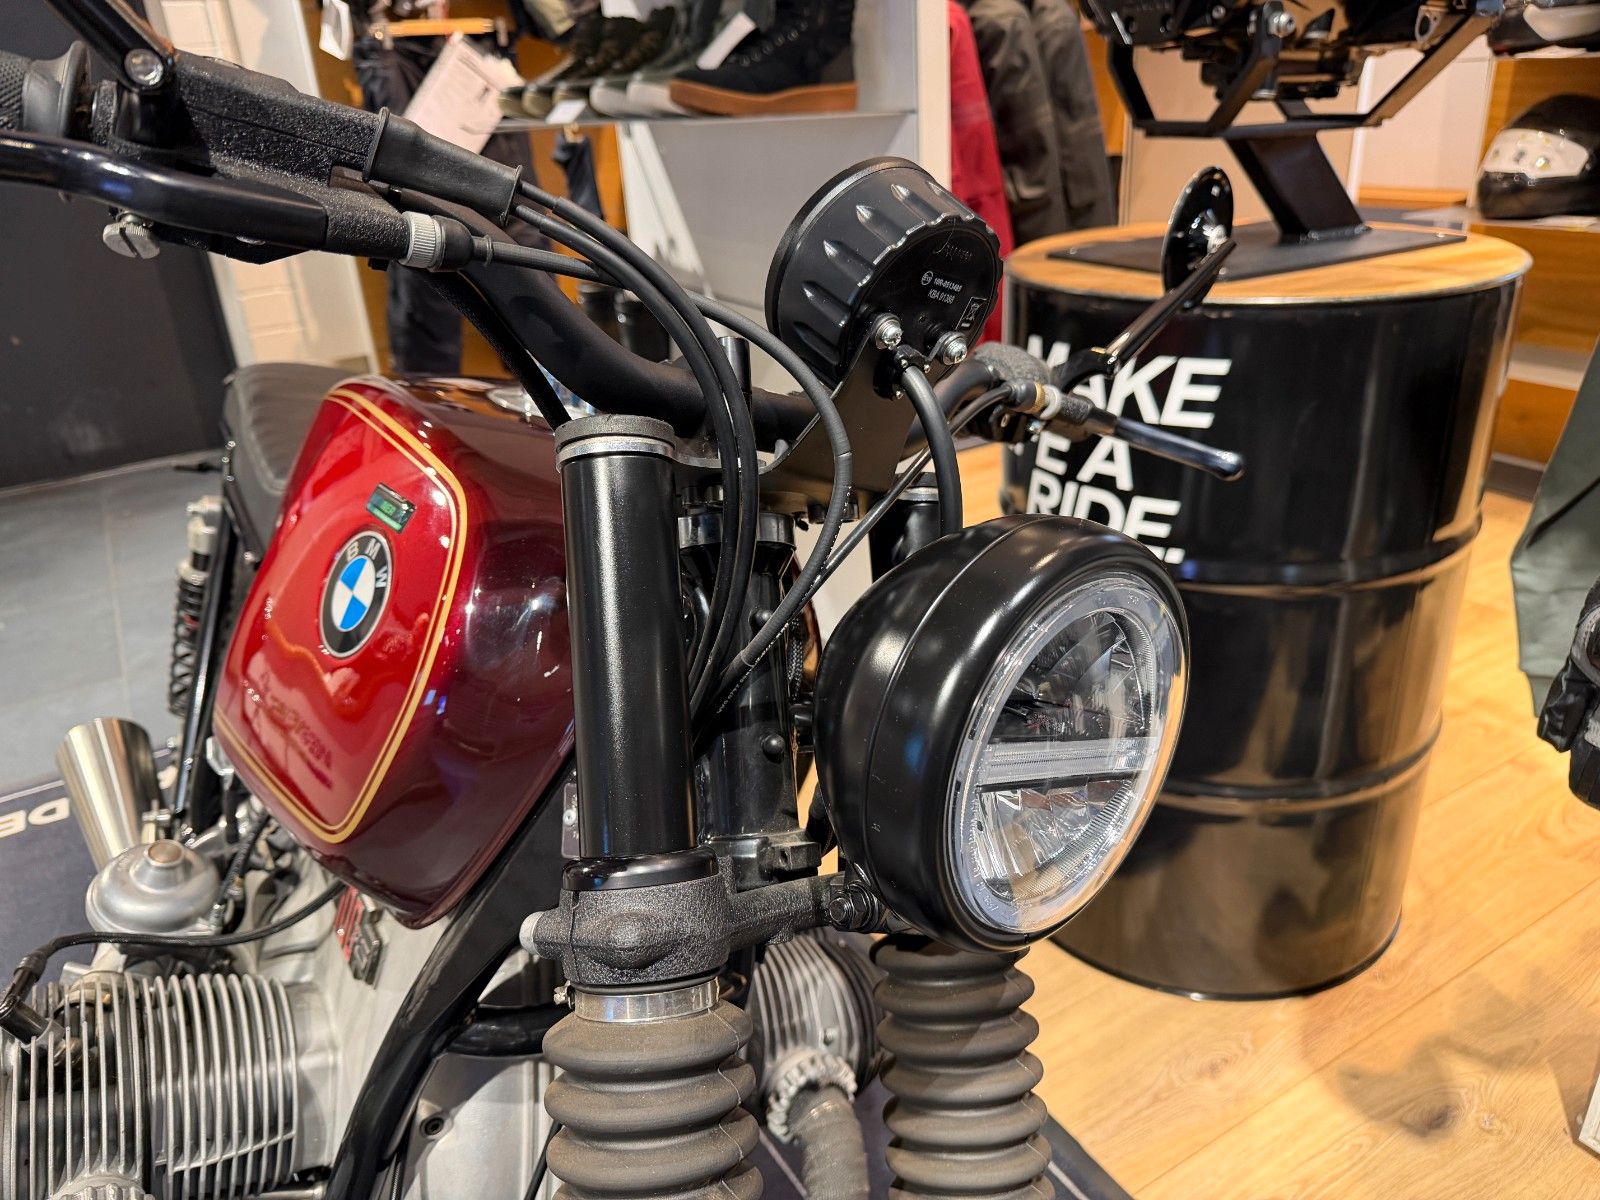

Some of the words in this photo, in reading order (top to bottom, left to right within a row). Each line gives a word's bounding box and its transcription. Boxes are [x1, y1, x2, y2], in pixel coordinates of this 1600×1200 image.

[1027, 334, 1232, 429] KE
[1076, 435, 1134, 491] A
[345, 537, 388, 588] BMW
